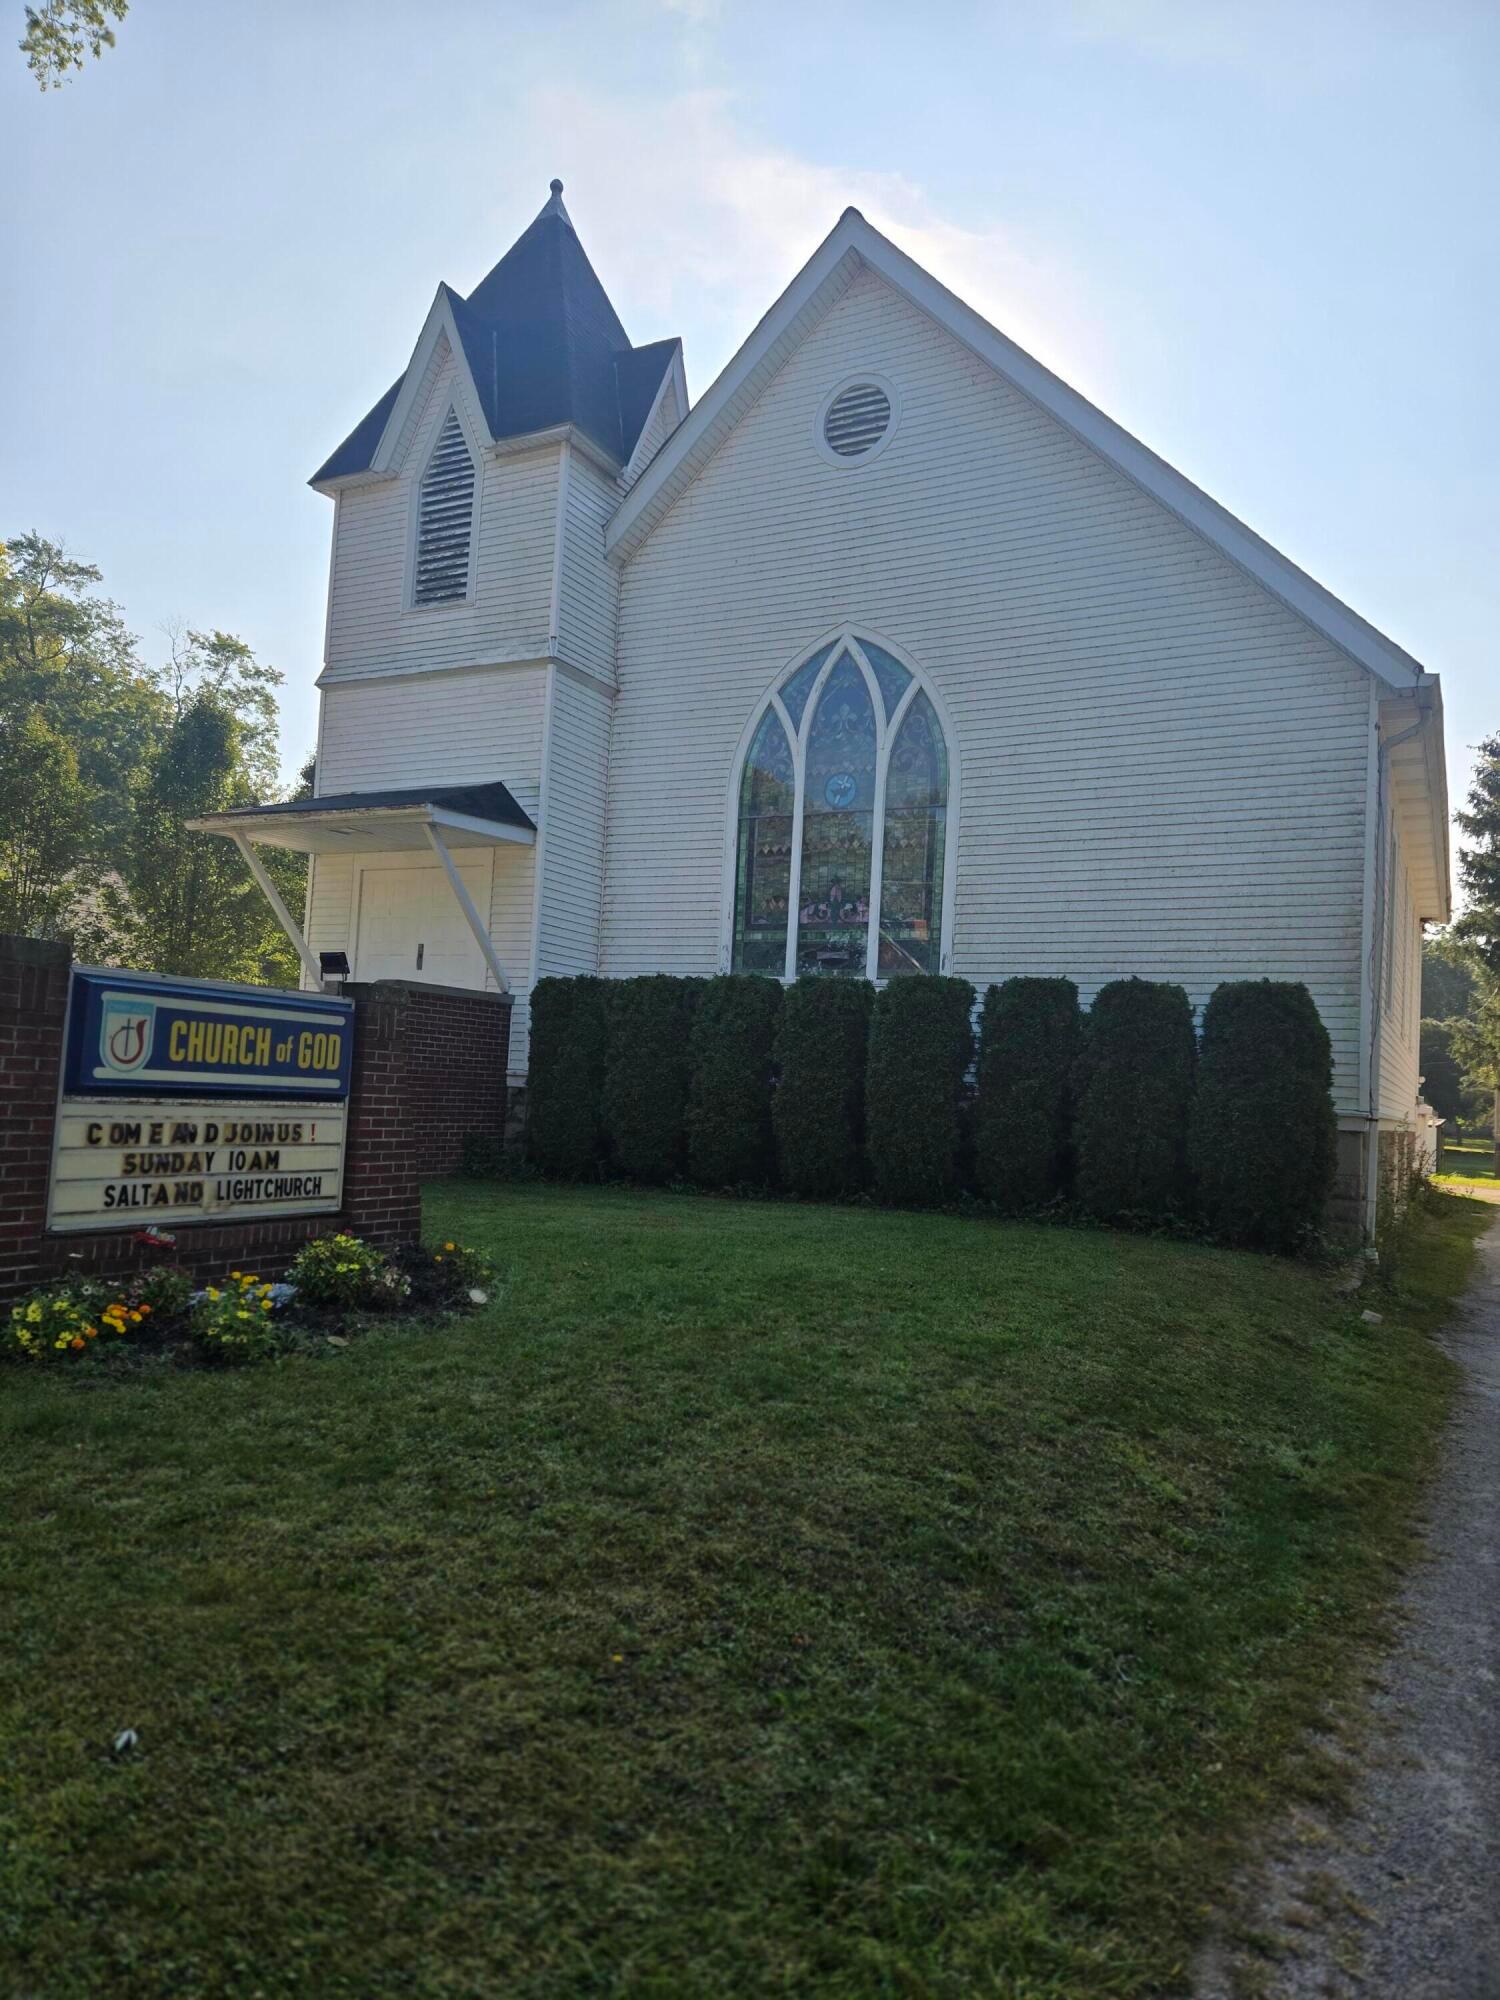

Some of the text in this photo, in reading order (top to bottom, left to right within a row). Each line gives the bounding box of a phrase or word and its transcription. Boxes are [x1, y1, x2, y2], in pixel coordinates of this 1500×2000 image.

[169, 1020, 342, 1071] CHURCH of GOD
[87, 1122, 163, 1145] COME
[171, 1122, 219, 1144] AND
[122, 1151, 215, 1174] SUNDAY
